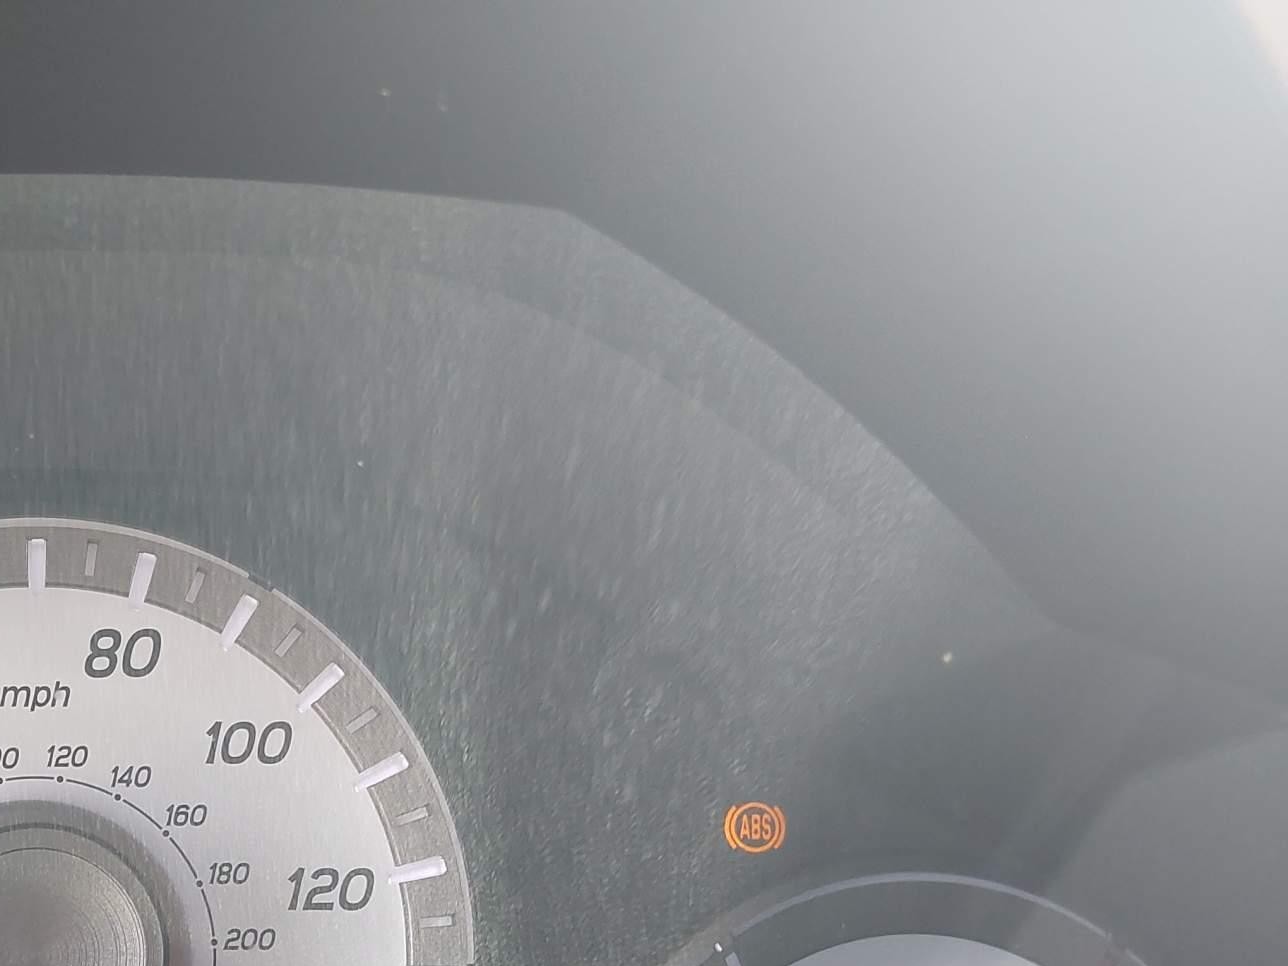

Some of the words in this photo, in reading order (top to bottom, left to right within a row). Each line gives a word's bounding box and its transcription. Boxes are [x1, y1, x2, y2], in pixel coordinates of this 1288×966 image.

[85, 629, 162, 679] 80
[0, 681, 71, 712] mph
[205, 721, 293, 765] 100
[47, 745, 89, 768] 120
[111, 765, 152, 788] 140
[166, 804, 208, 827] 160
[740, 813, 772, 841] ABS
[209, 862, 250, 885] 180
[288, 867, 375, 912] 120
[222, 928, 276, 951] 200
